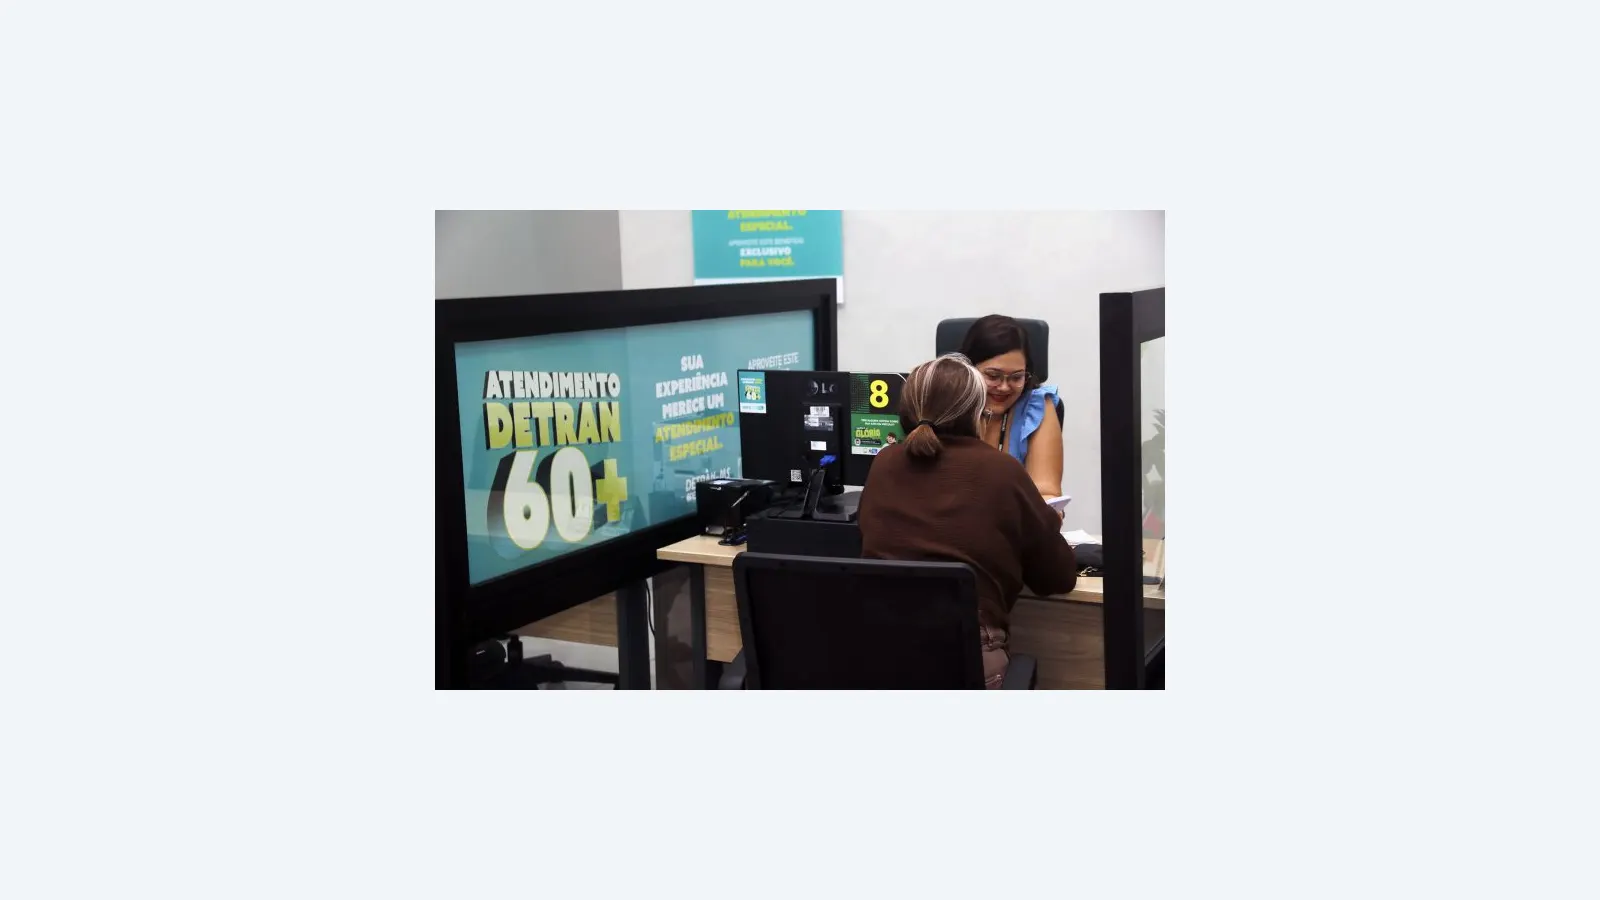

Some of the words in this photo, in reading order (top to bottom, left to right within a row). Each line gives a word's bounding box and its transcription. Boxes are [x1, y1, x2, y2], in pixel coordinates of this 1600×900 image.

[740, 246, 792, 257] EXCLUSIVO
[680, 354, 704, 372] SUA
[748, 355, 783, 370] APROVEITE
[784, 352, 800, 365] ESTE
[484, 370, 621, 398] ATENDIMENTO
[655, 371, 729, 398] EXPERIÊNCIA
[869, 379, 889, 409] 8
[662, 398, 705, 420] MERECE
[707, 392, 725, 409] UM
[485, 401, 622, 449] DETRAN
[655, 411, 735, 443] ATENDIMENTO
[669, 435, 724, 462] ESPECIAL.
[500, 446, 628, 550] 60+
